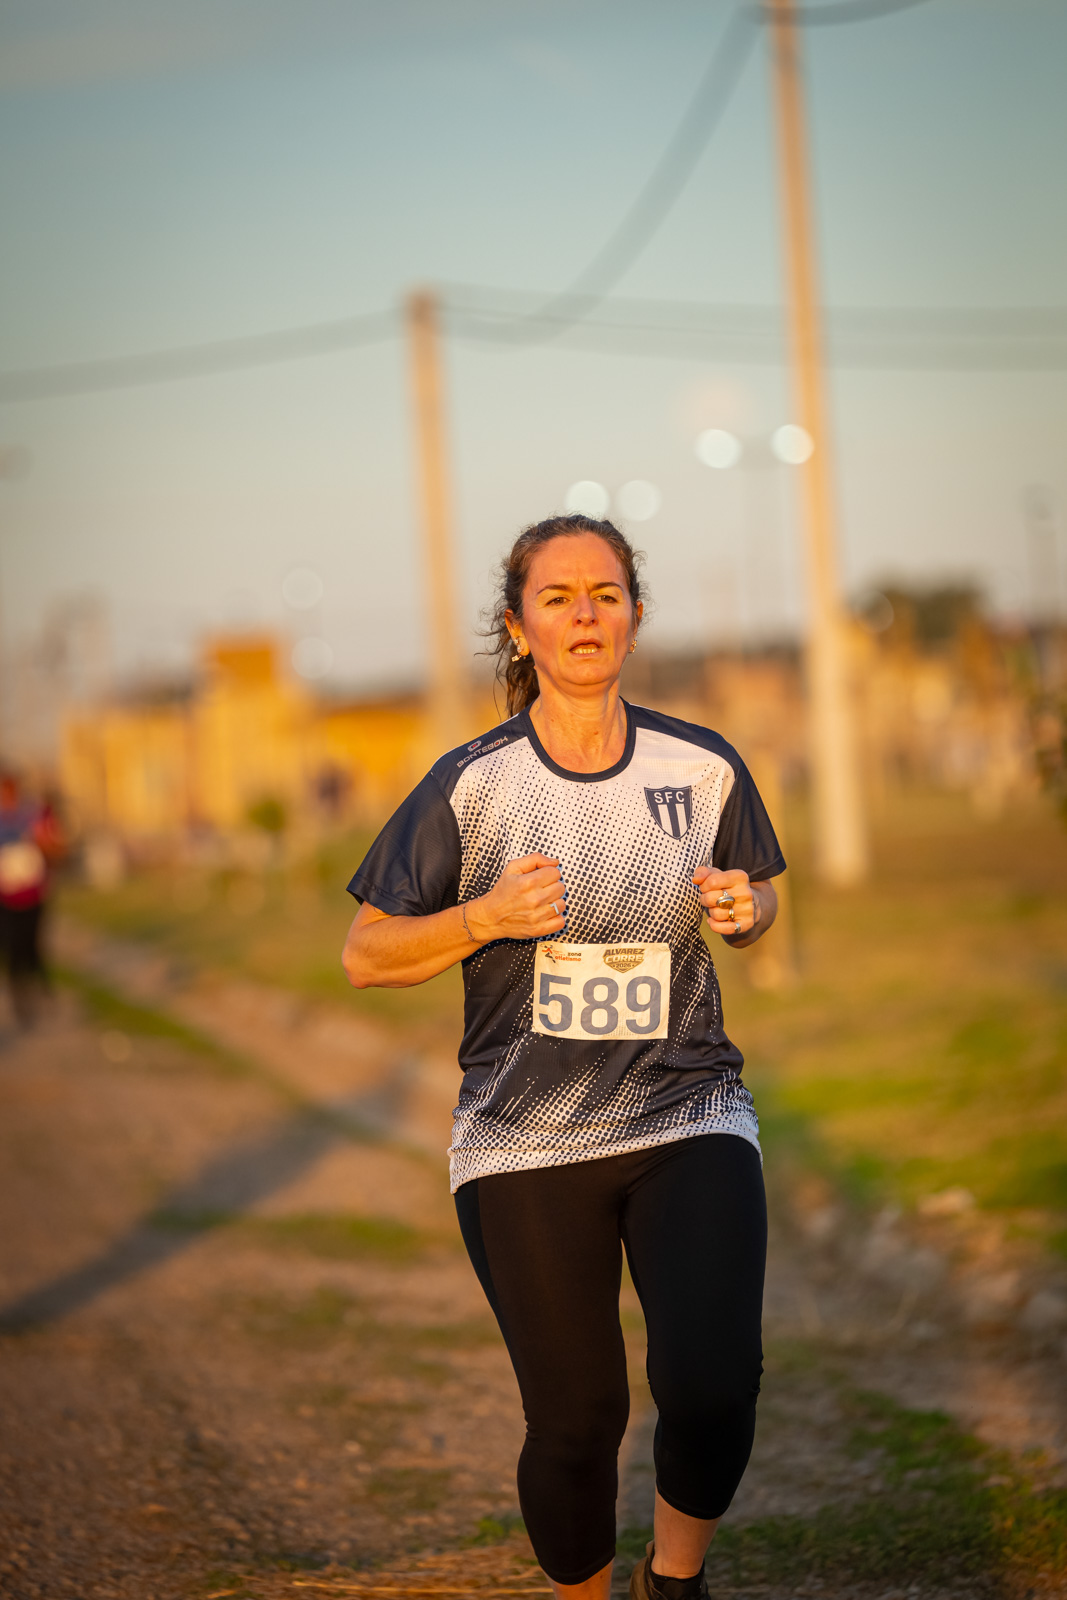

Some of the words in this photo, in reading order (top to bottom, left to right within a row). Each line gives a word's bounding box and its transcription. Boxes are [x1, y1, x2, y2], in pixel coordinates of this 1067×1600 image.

[653, 791, 685, 804] SFC
[603, 948, 645, 957] ALVAREZ
[605, 955, 643, 963] CORRE
[538, 972, 662, 1036] 589
